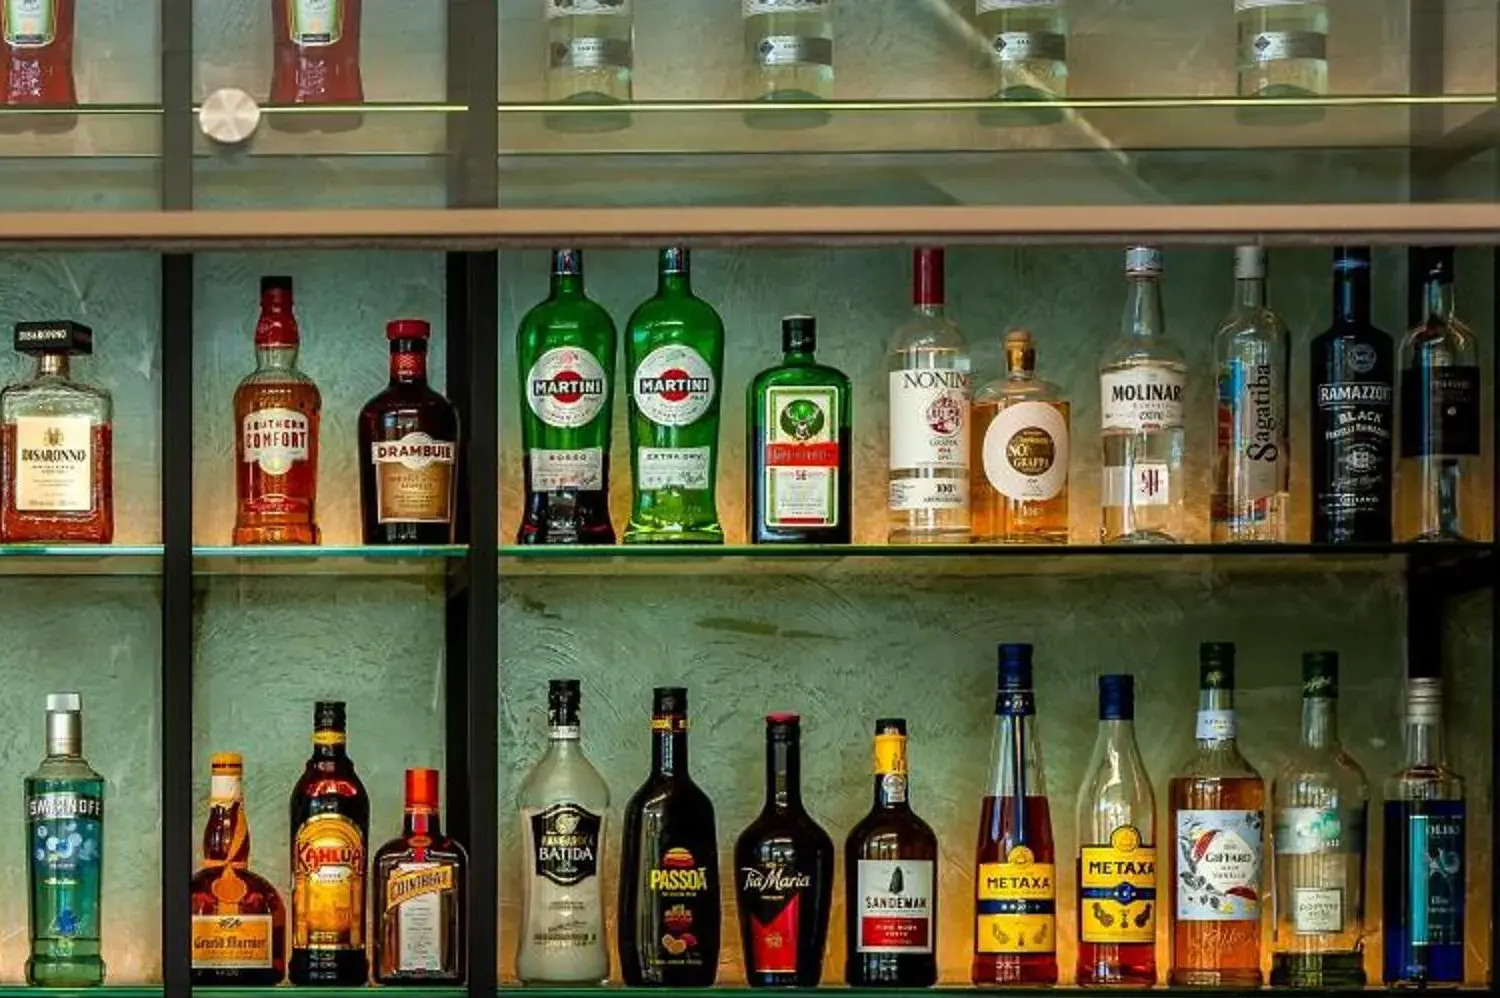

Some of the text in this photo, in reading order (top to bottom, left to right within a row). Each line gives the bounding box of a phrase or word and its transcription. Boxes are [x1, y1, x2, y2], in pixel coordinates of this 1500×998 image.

[642, 379, 708, 393] MARTINI
[904, 372, 968, 388] NONIN
[535, 381, 602, 395] MARTINI
[1111, 384, 1182, 402] MOLINAR
[1246, 364, 1278, 462] Sagatiba
[1339, 411, 1383, 424] BLACK
[246, 431, 307, 449] COMFORT
[21, 448, 86, 462] DISARONNO
[539, 847, 593, 861] BATIDA
[1089, 861, 1155, 874] METAXA
[760, 866, 813, 892] Maria
[987, 877, 1051, 889] METAXA
[865, 896, 927, 909] SANDEMAN
[194, 935, 225, 949] Grand
